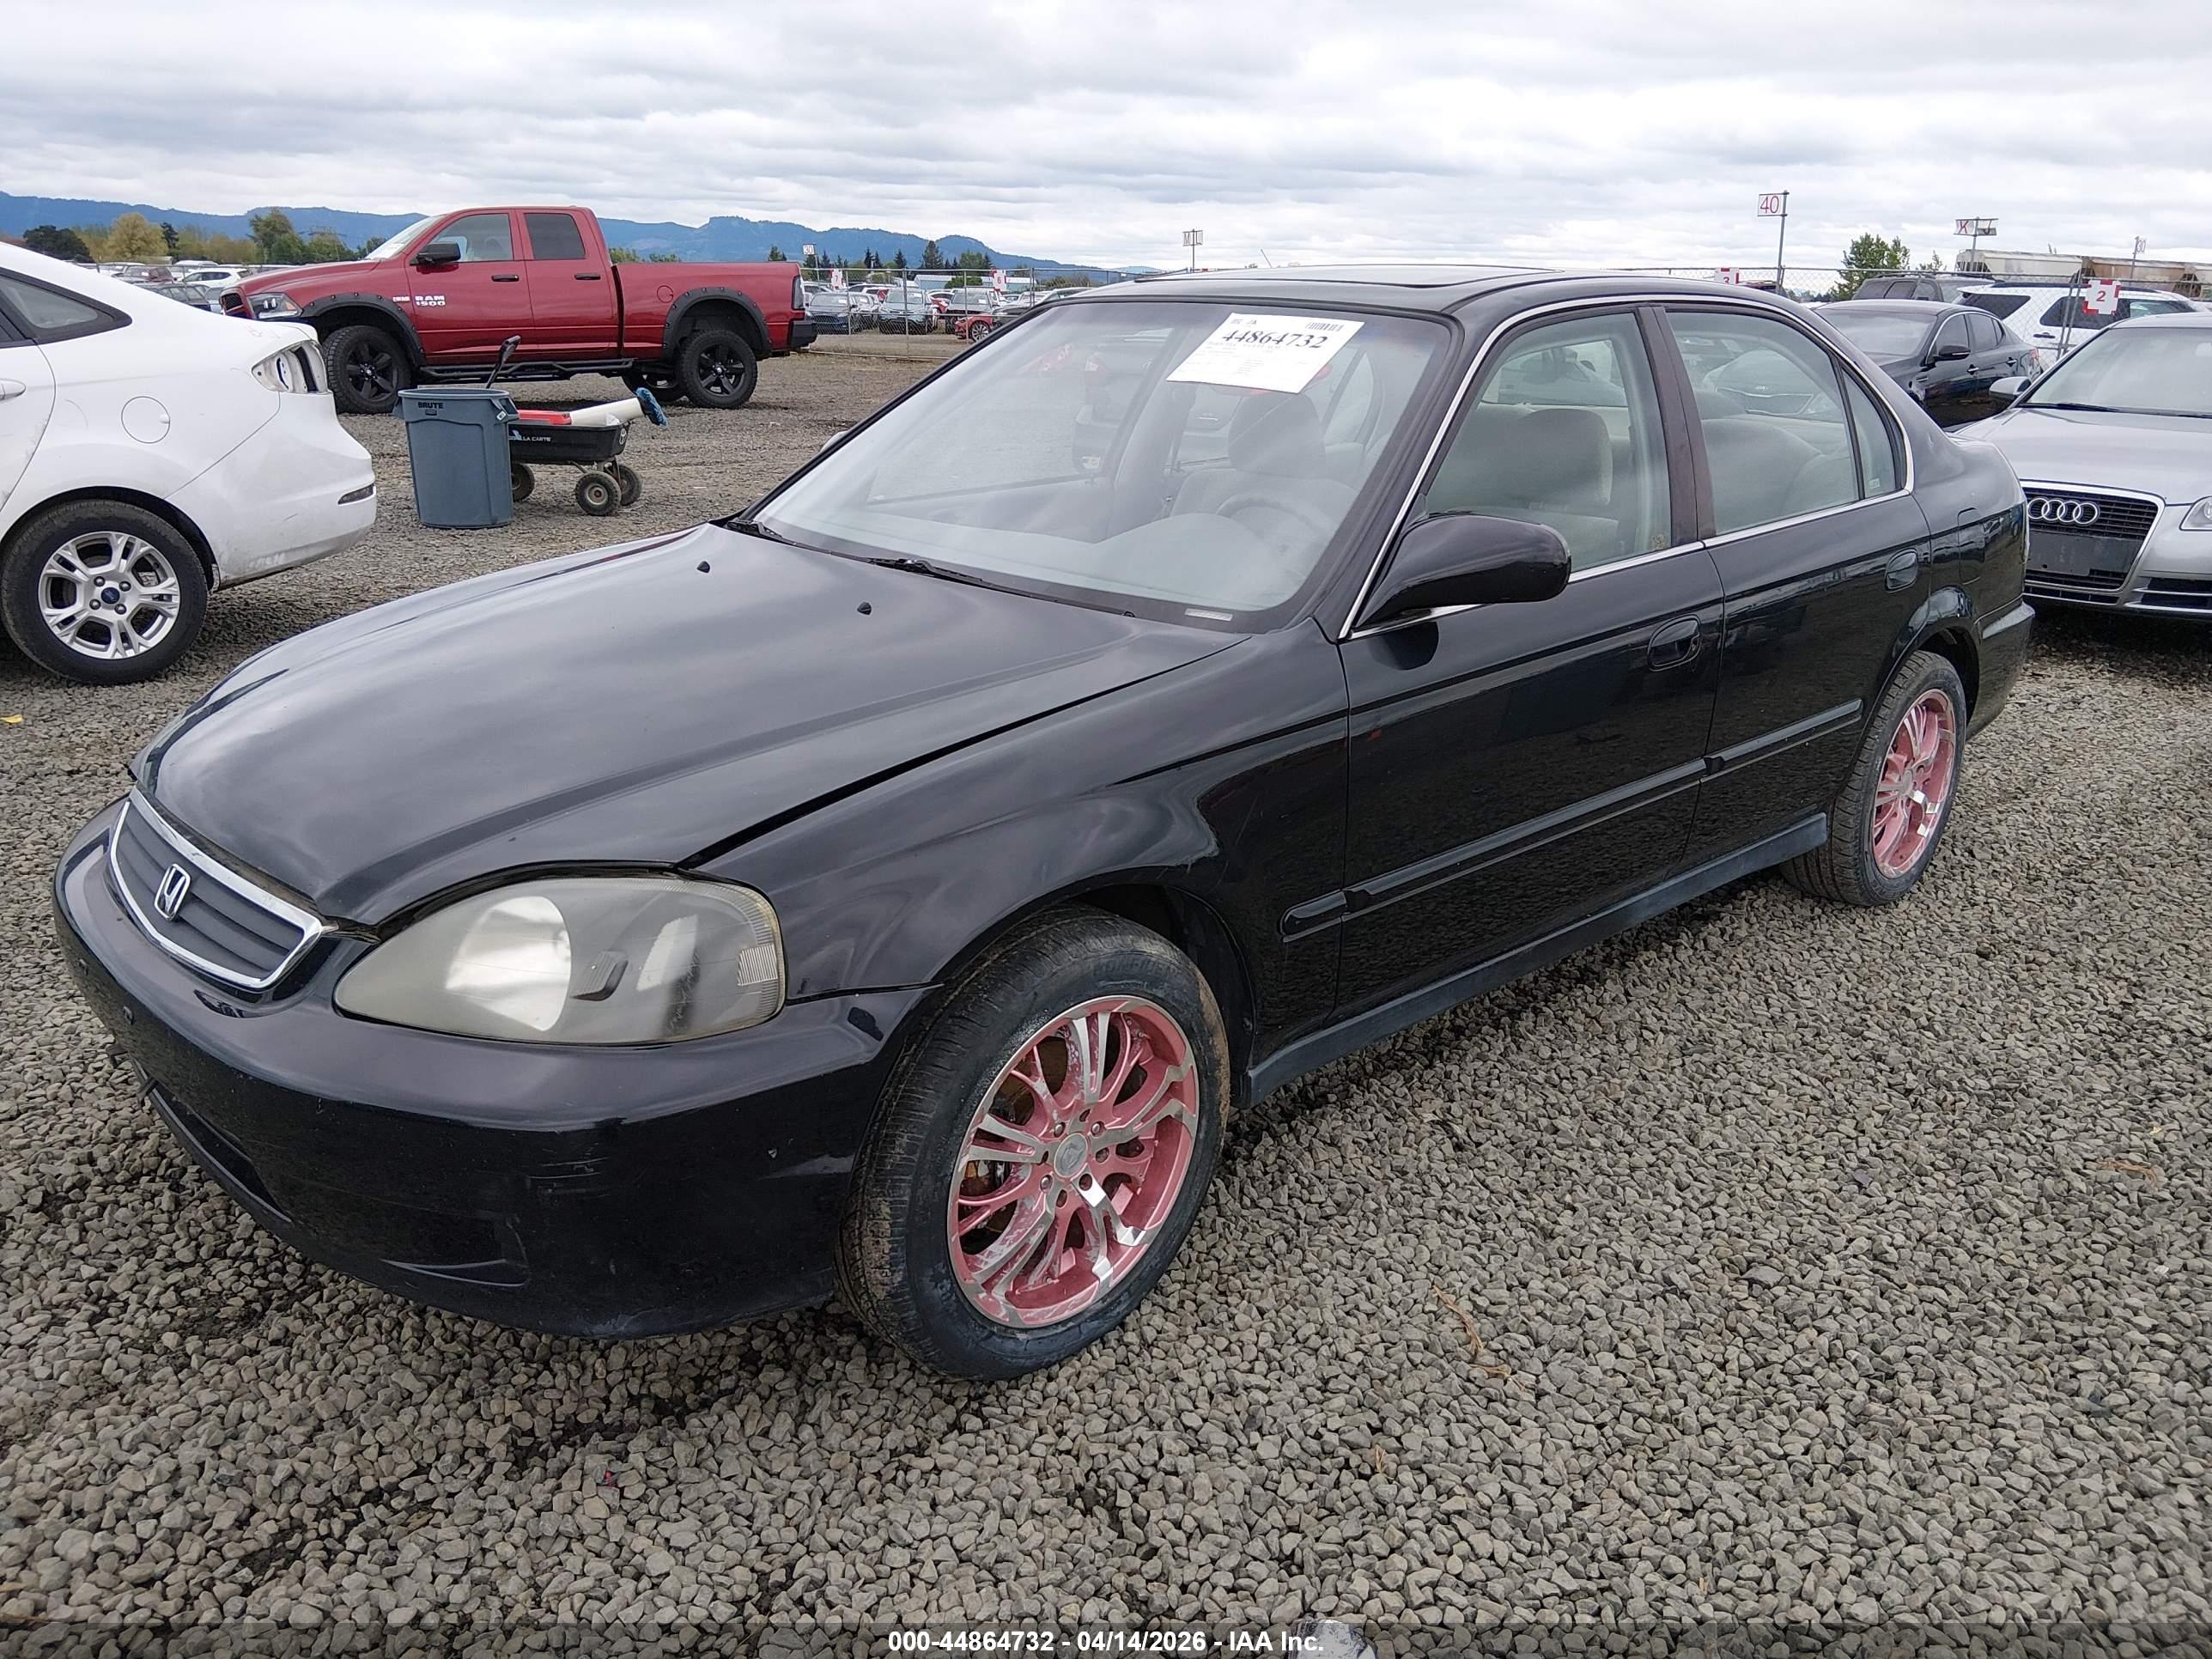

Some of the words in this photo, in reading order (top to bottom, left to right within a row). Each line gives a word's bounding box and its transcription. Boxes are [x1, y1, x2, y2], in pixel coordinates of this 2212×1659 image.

[1760, 196, 1780, 214] 40
[1958, 220, 1969, 234] K
[2096, 290, 2106, 302] 2
[1223, 330, 1328, 349] 44864732
